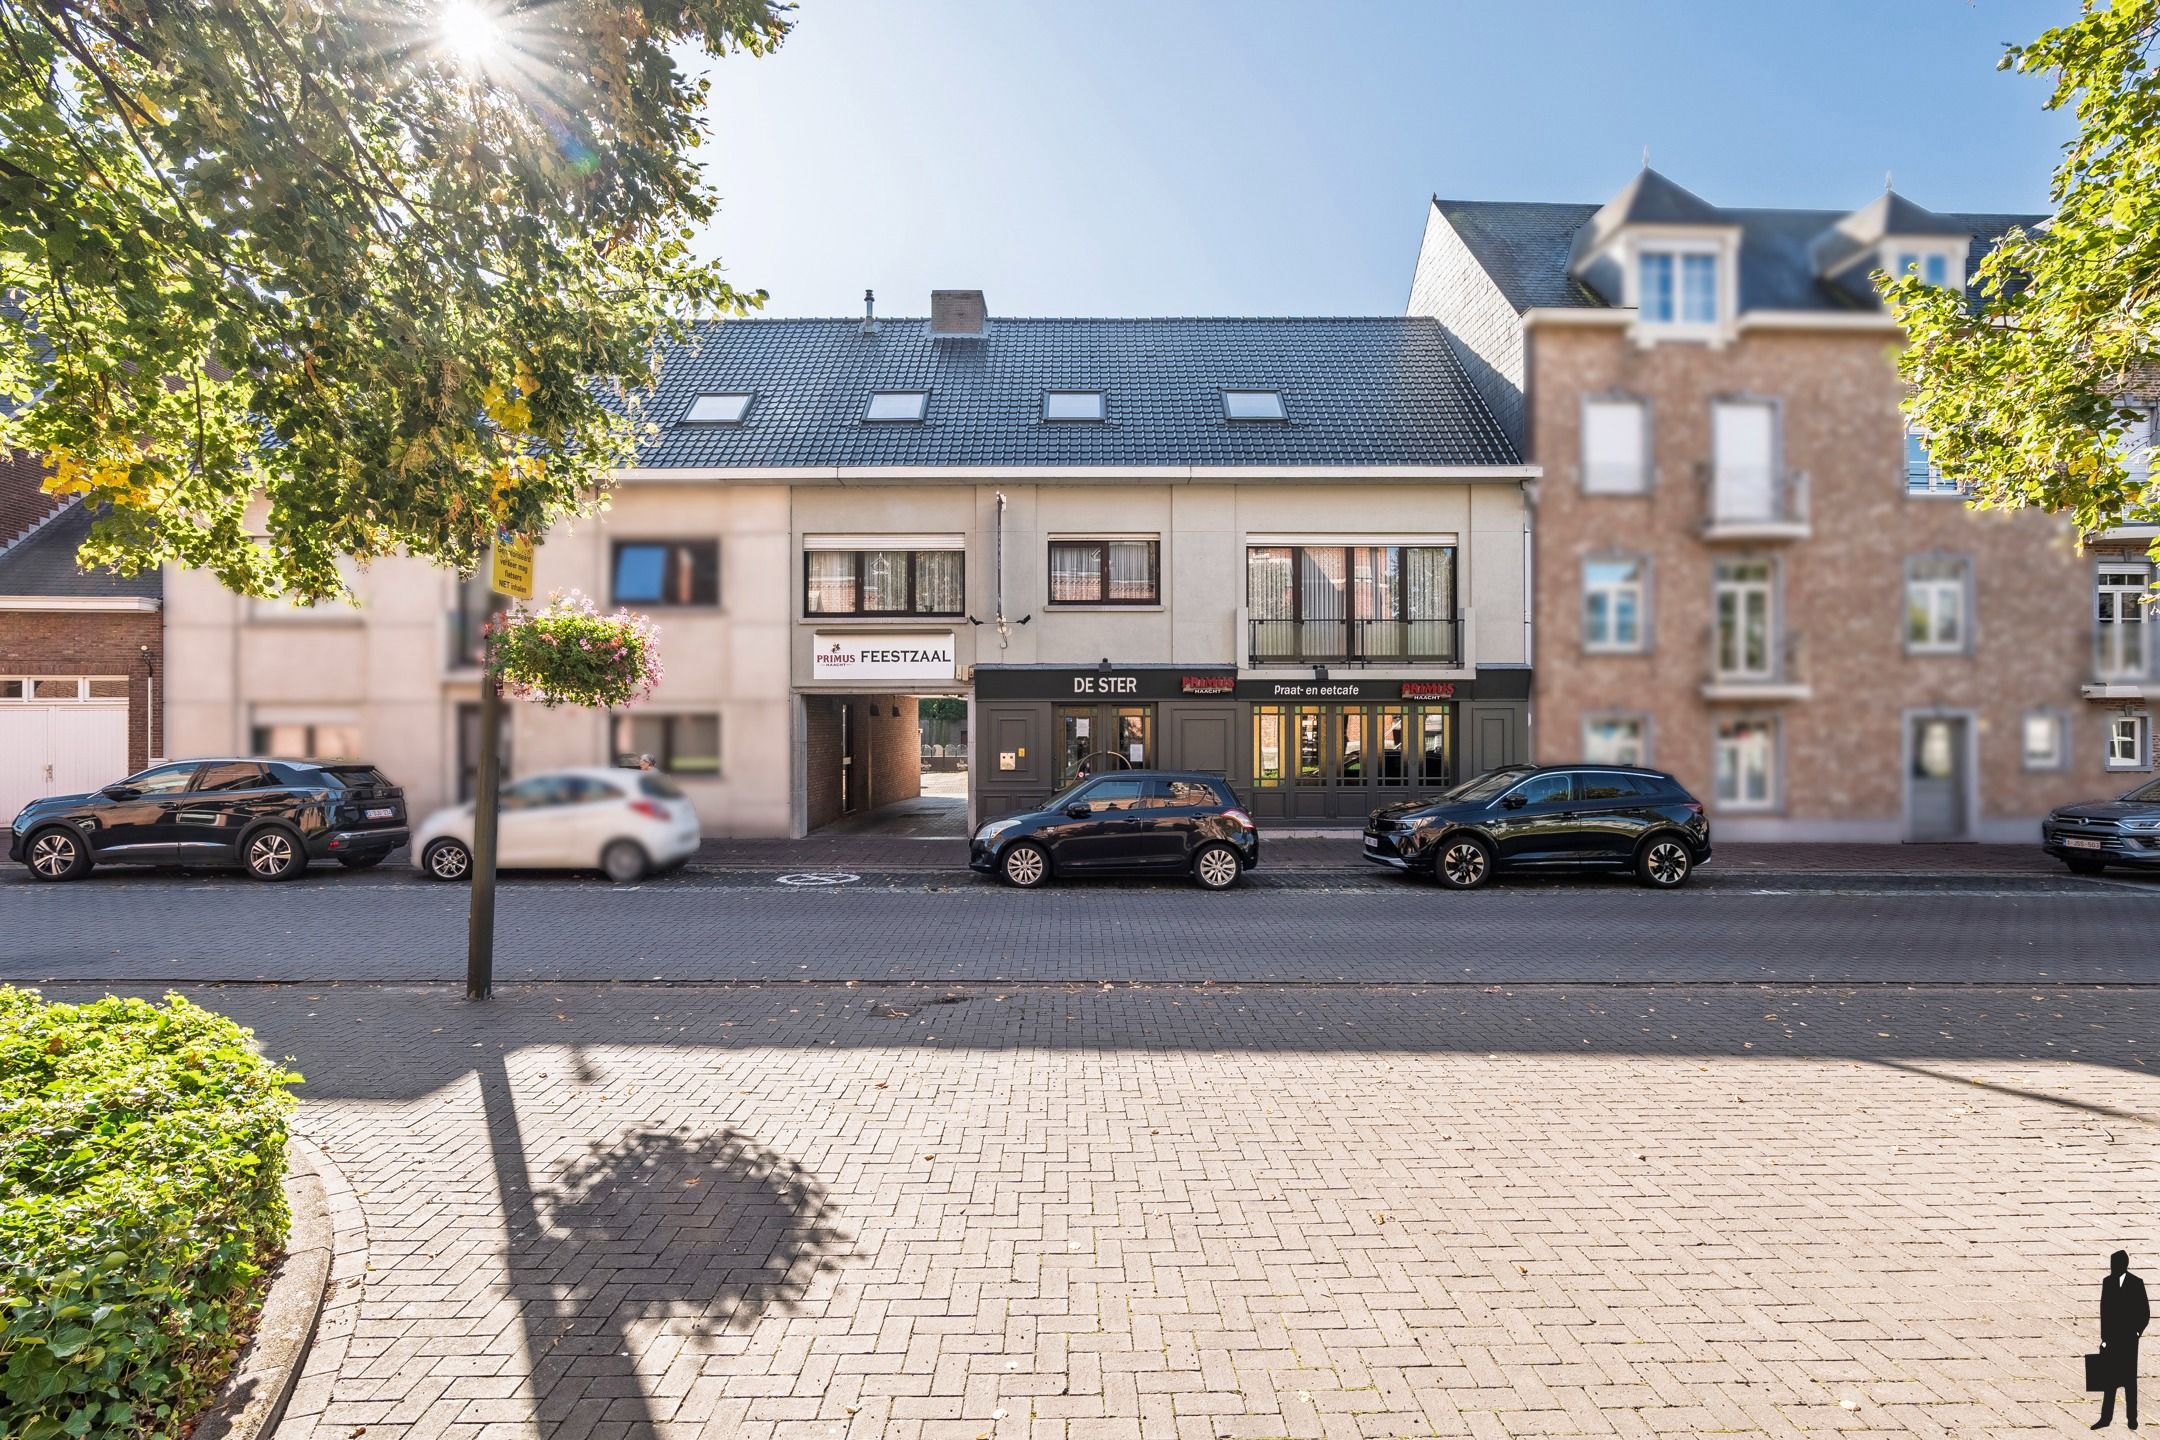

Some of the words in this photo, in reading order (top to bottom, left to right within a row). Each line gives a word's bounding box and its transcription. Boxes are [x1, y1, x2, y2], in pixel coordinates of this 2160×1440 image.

[504, 569, 522, 582] fietsers
[518, 564, 528, 575] mag
[816, 654, 856, 663] PRIMUS
[861, 650, 952, 663] FEESTZAAL
[1074, 677, 1094, 693] DE
[1098, 677, 1137, 693] STER
[1181, 676, 1235, 688] PRIMUS
[1274, 684, 1304, 695] Praat-
[1305, 686, 1318, 695] en
[1320, 684, 1360, 695] eetcafe
[1401, 682, 1455, 695] PRIMUS
